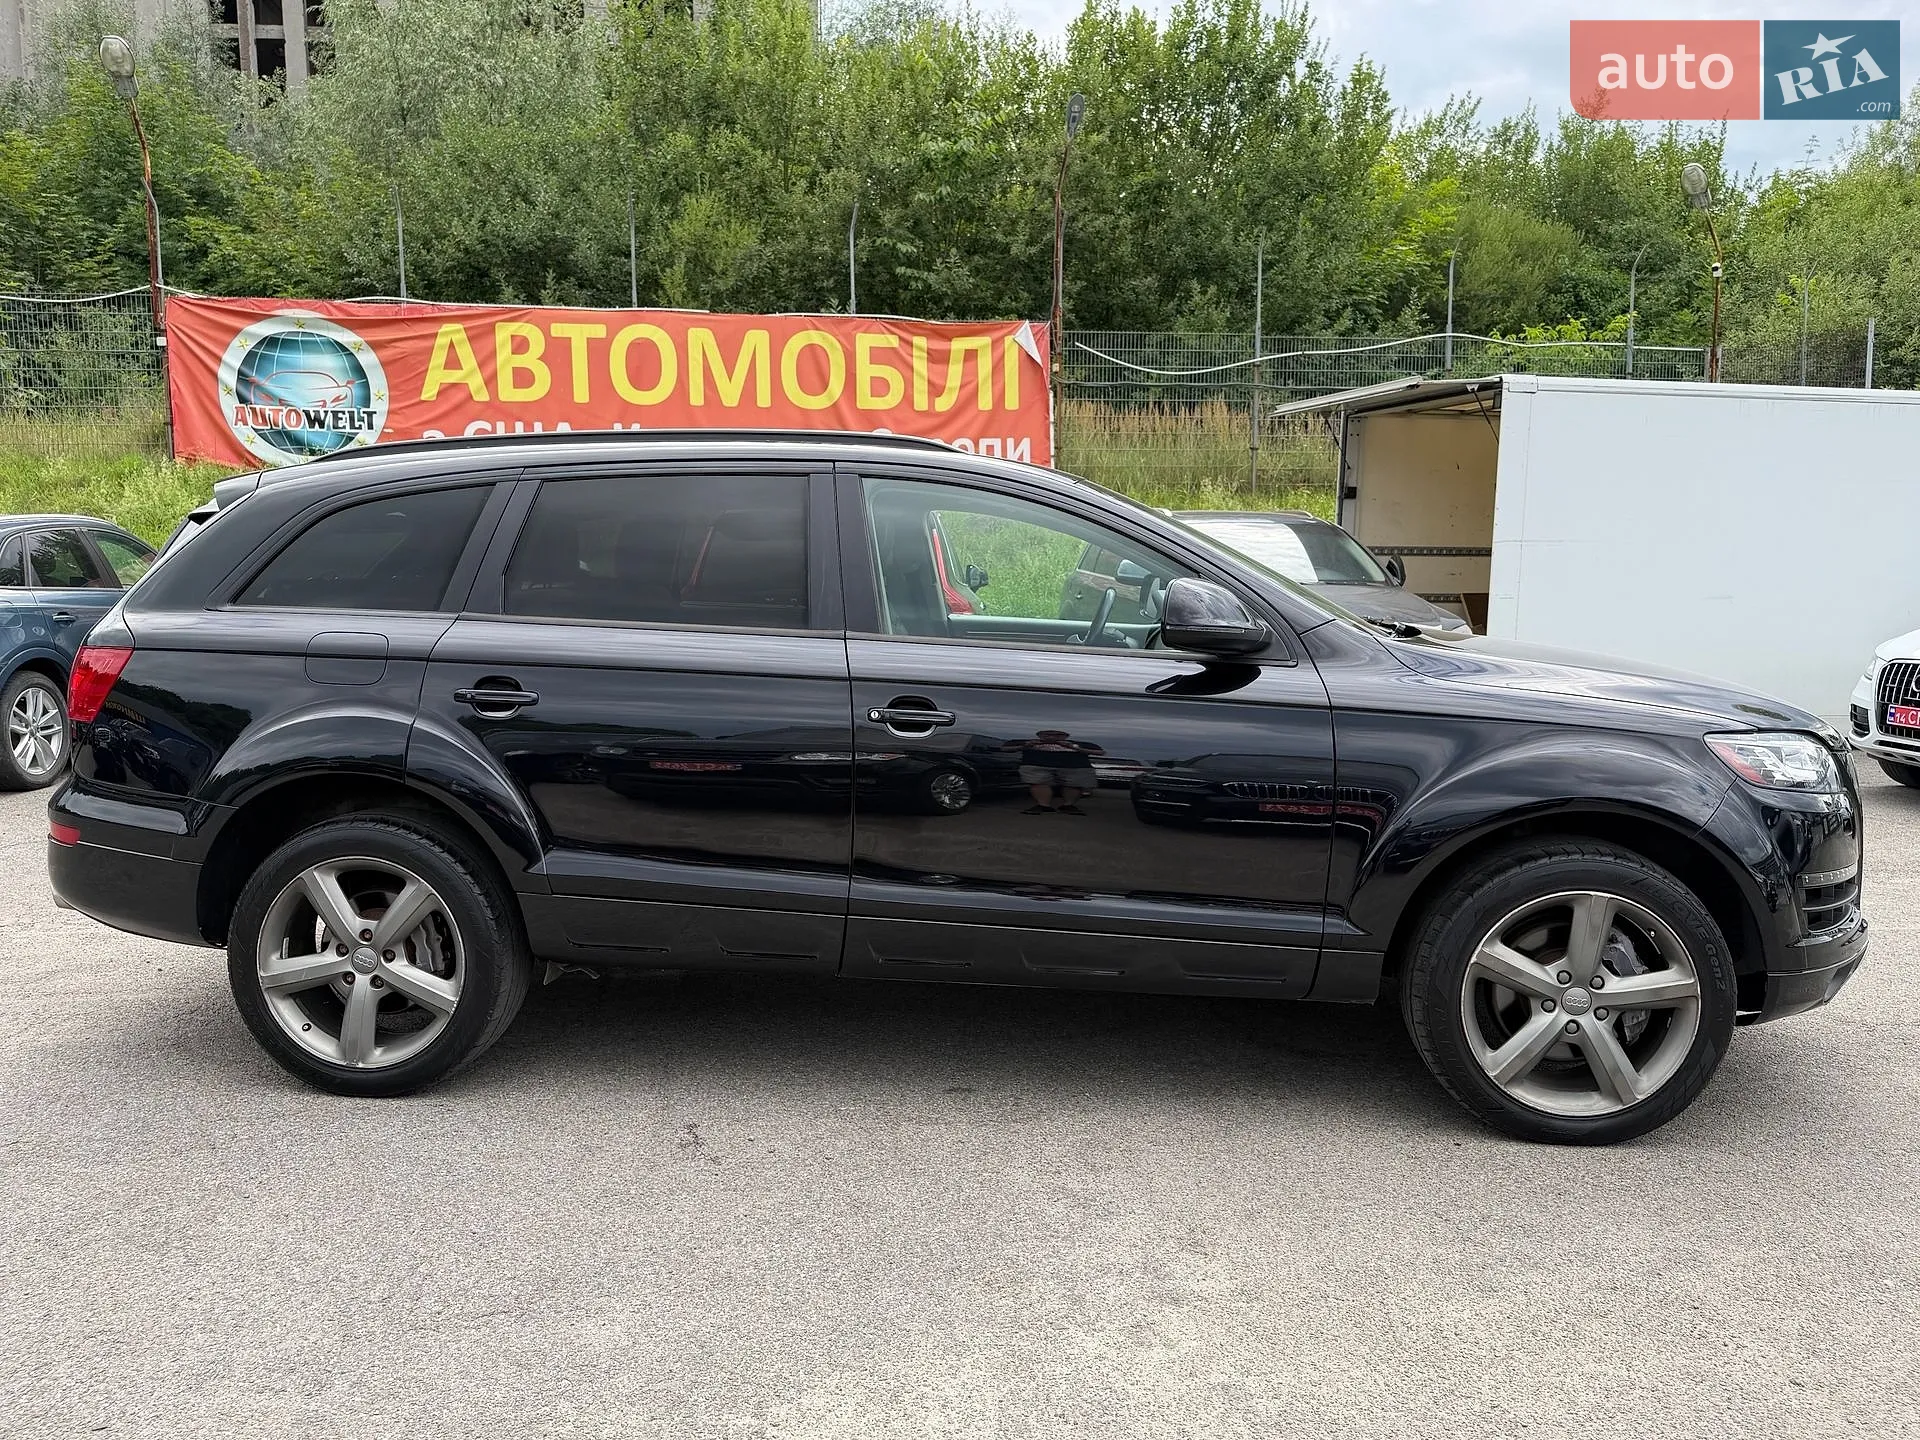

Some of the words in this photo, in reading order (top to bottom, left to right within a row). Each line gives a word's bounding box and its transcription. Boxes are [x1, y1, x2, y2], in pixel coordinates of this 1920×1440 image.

[420, 322, 1020, 413] АВТОМОБІЛІ
[233, 405, 378, 432] AUTOWELT
[1895, 712, 1906, 724] 14
